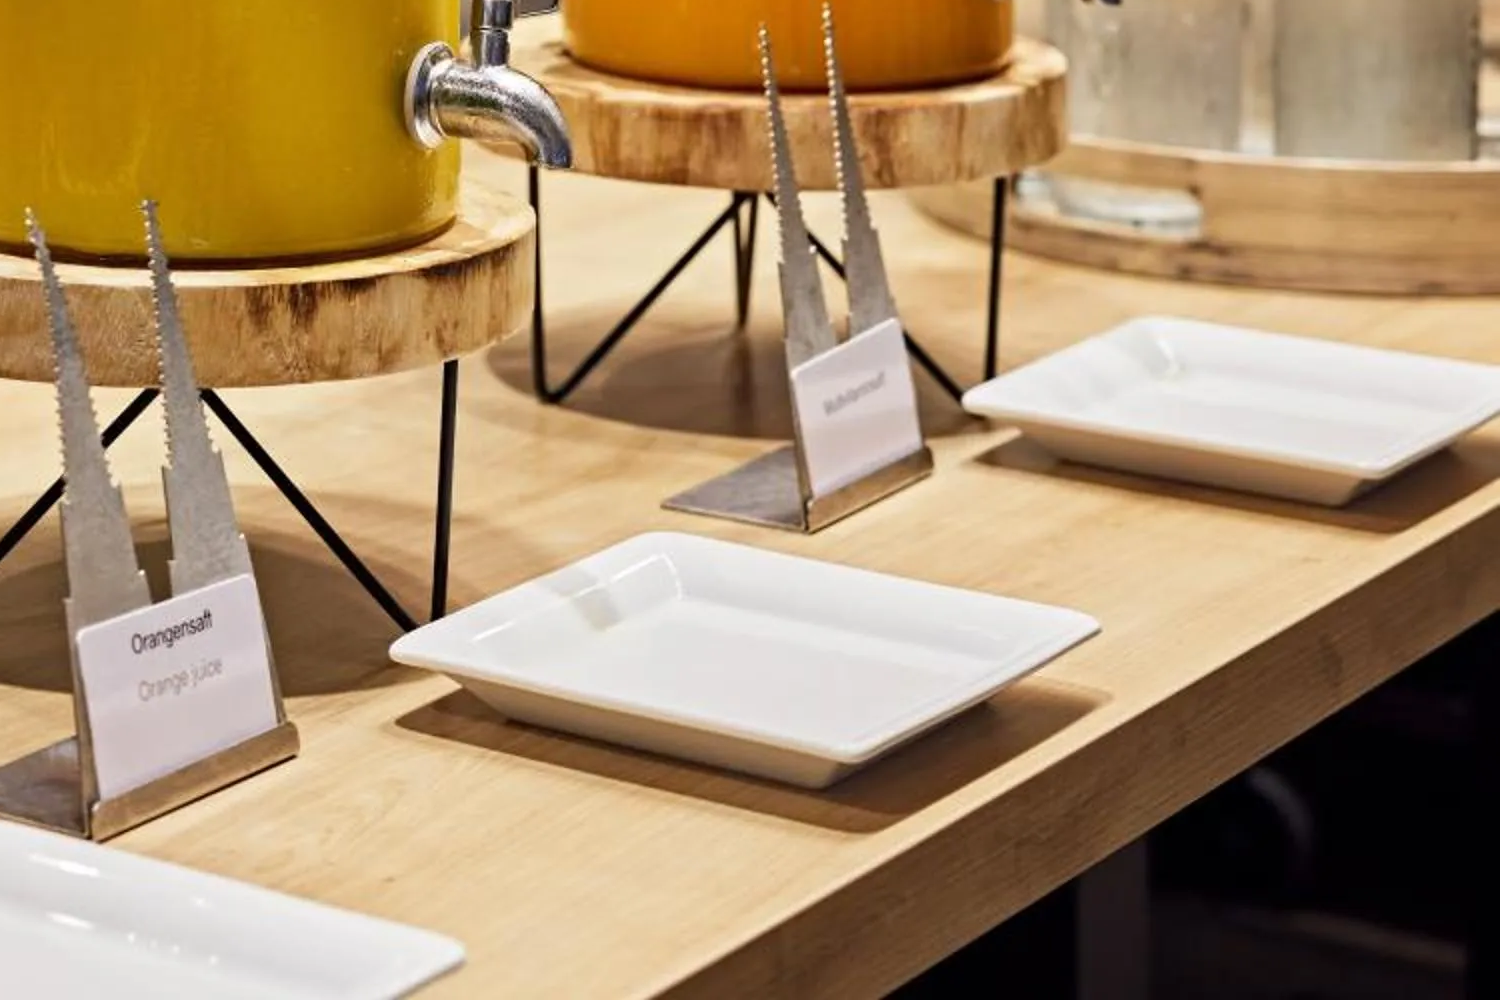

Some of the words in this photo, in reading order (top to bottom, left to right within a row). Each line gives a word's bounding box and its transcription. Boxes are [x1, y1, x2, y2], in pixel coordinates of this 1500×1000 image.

[131, 608, 213, 655] Orangensaft
[138, 669, 190, 702] Orange
[189, 658, 223, 688] juice
